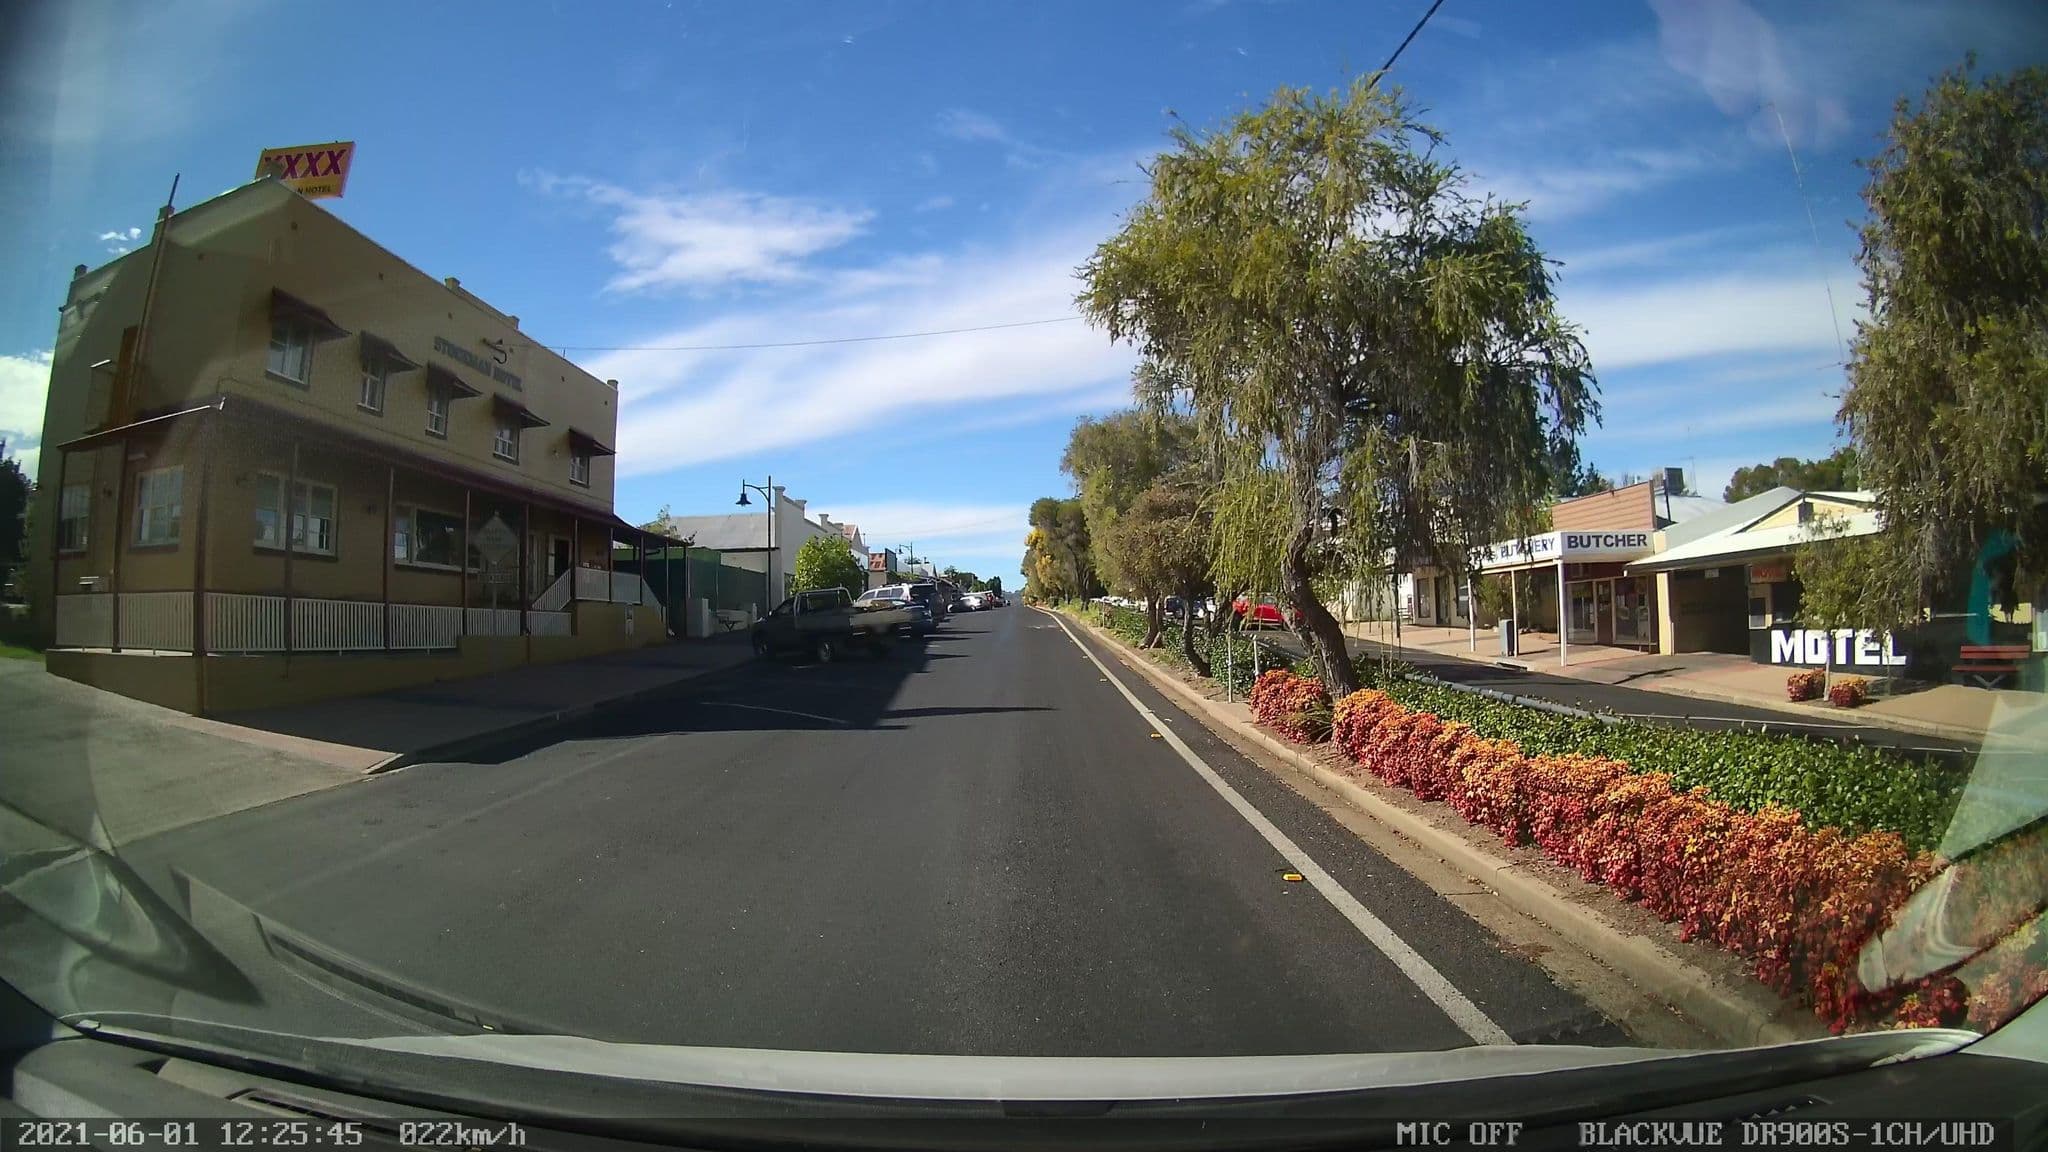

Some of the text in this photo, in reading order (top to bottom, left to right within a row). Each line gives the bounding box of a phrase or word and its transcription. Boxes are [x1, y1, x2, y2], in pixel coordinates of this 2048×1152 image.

[1500, 537, 1555, 557] BUTHERY
[1567, 534, 1647, 549] BUTCHER
[1771, 628, 1907, 666] MOTEL
